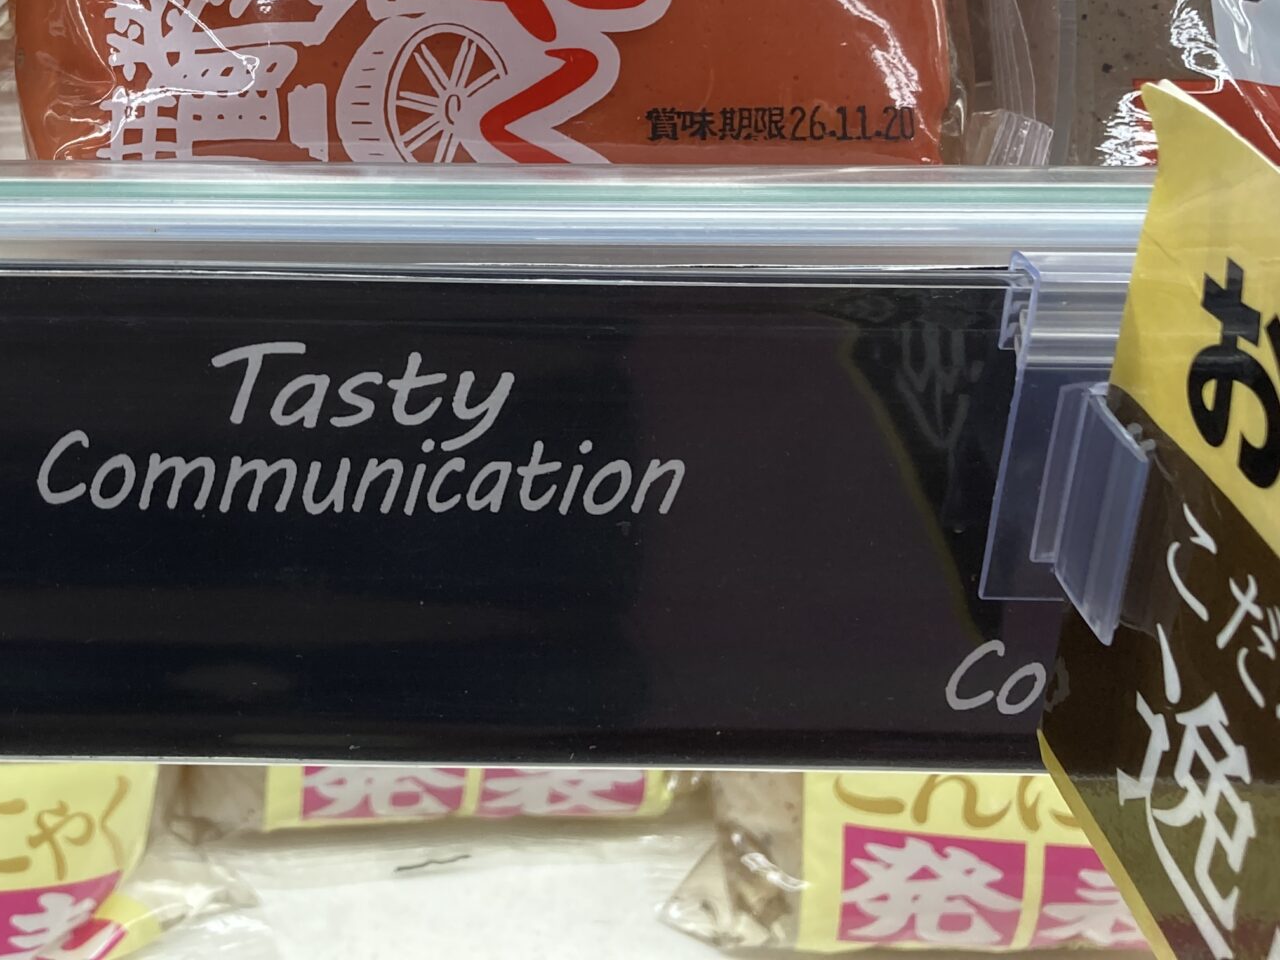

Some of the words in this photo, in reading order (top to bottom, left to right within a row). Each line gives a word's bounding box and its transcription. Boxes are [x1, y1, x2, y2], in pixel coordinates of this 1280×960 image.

[646, 105, 916, 142] 賞味期限26.11.20
[211, 341, 515, 451] Tasty
[36, 429, 686, 516] Communication
